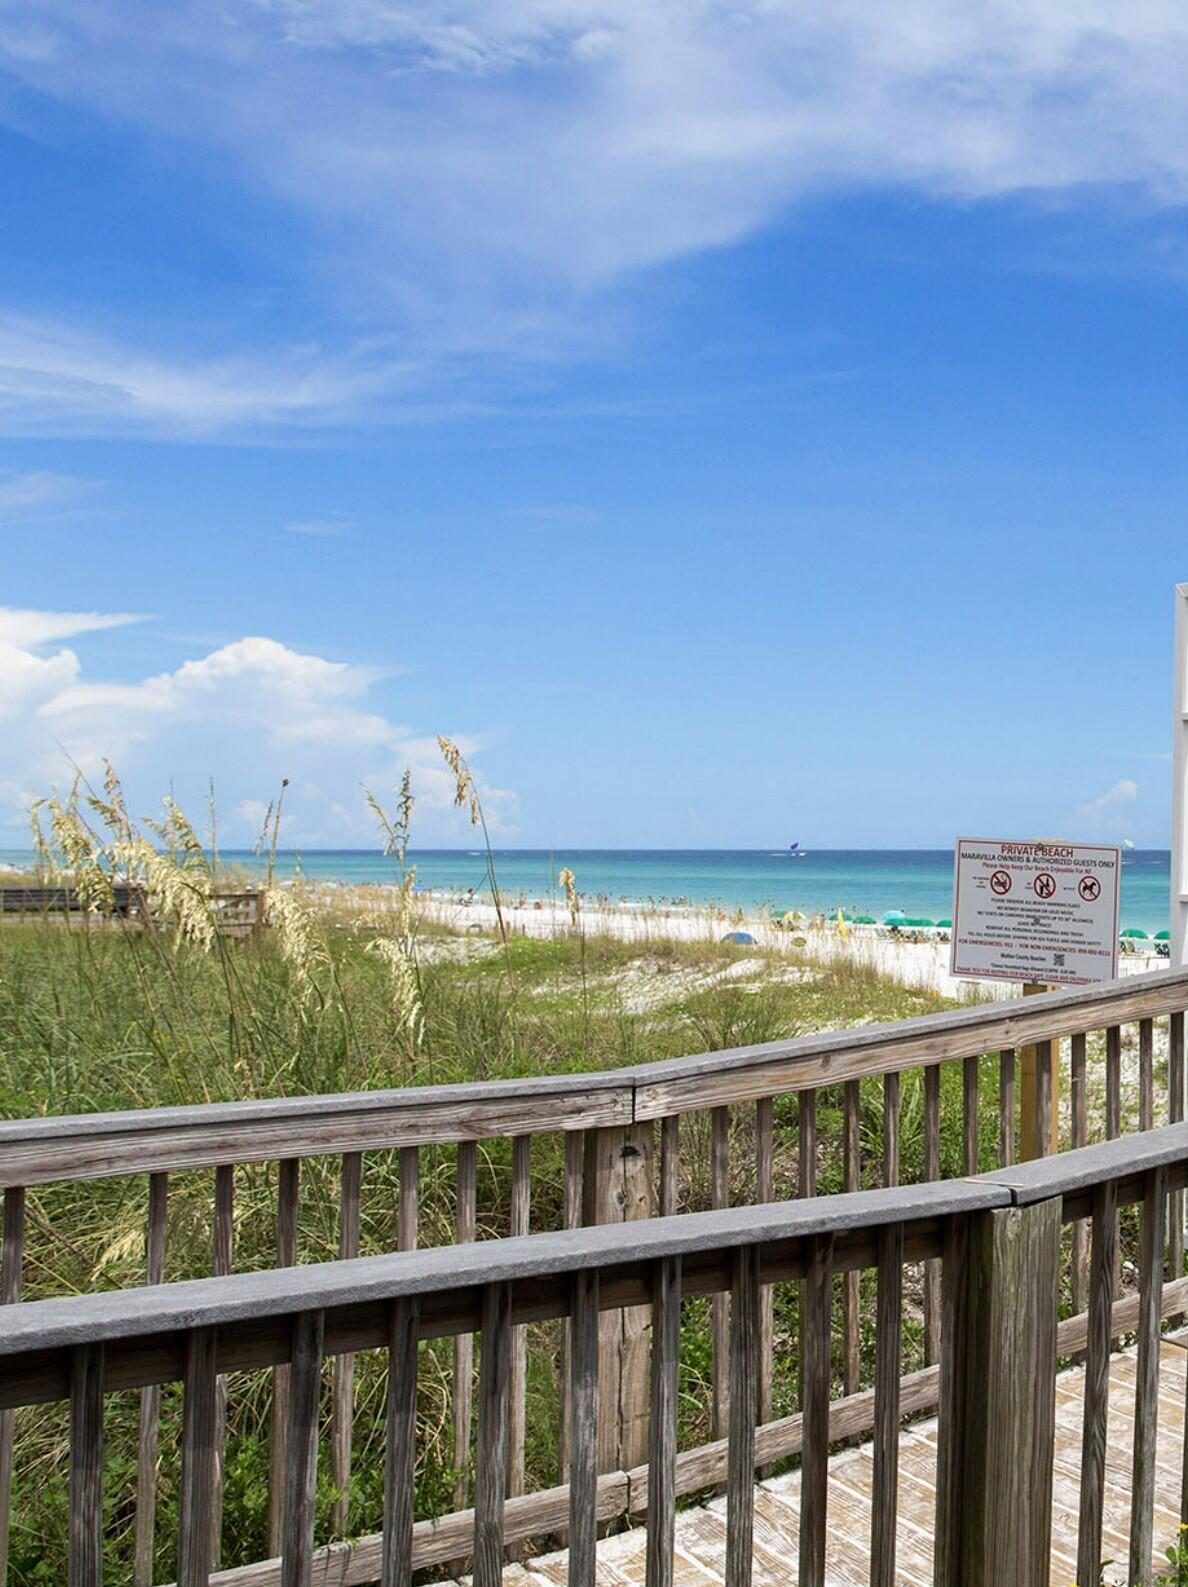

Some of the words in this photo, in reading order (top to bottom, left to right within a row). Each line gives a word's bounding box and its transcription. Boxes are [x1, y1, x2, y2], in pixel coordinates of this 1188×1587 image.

[1001, 845, 1039, 856] PRIVATE
[1041, 847, 1073, 858] BEACH
[961, 852, 996, 861] MARAVILLA
[997, 854, 1025, 863] OWNERS
[1032, 856, 1072, 867] AUTHORIZED
[1073, 859, 1097, 868] GUESTS
[1098, 860, 1115, 869] ONLY
